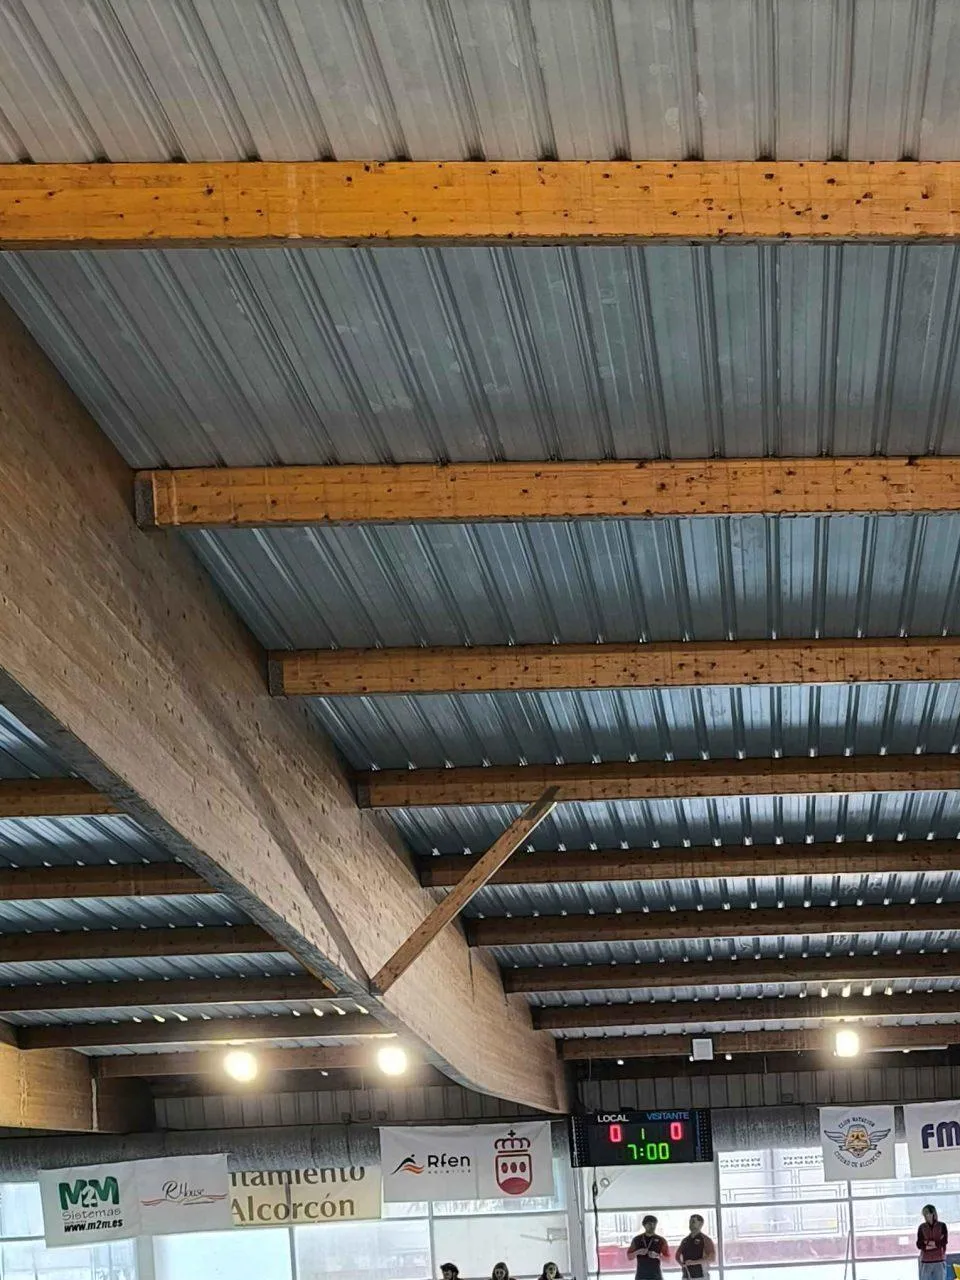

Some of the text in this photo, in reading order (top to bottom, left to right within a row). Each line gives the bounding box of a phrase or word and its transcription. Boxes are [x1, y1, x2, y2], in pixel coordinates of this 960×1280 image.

[597, 1112, 690, 1123] LOCAL VISITANTE
[610, 1124, 621, 1142] 0
[670, 1122, 682, 1140] 0
[627, 1142, 670, 1160] 7:00
[428, 1153, 471, 1167] Rfen
[58, 1176, 120, 1210] M2M
[62, 1208, 121, 1221] Sistemas
[231, 1192, 355, 1222] Alcorcón
[64, 1219, 123, 1233] www.m2m.es
